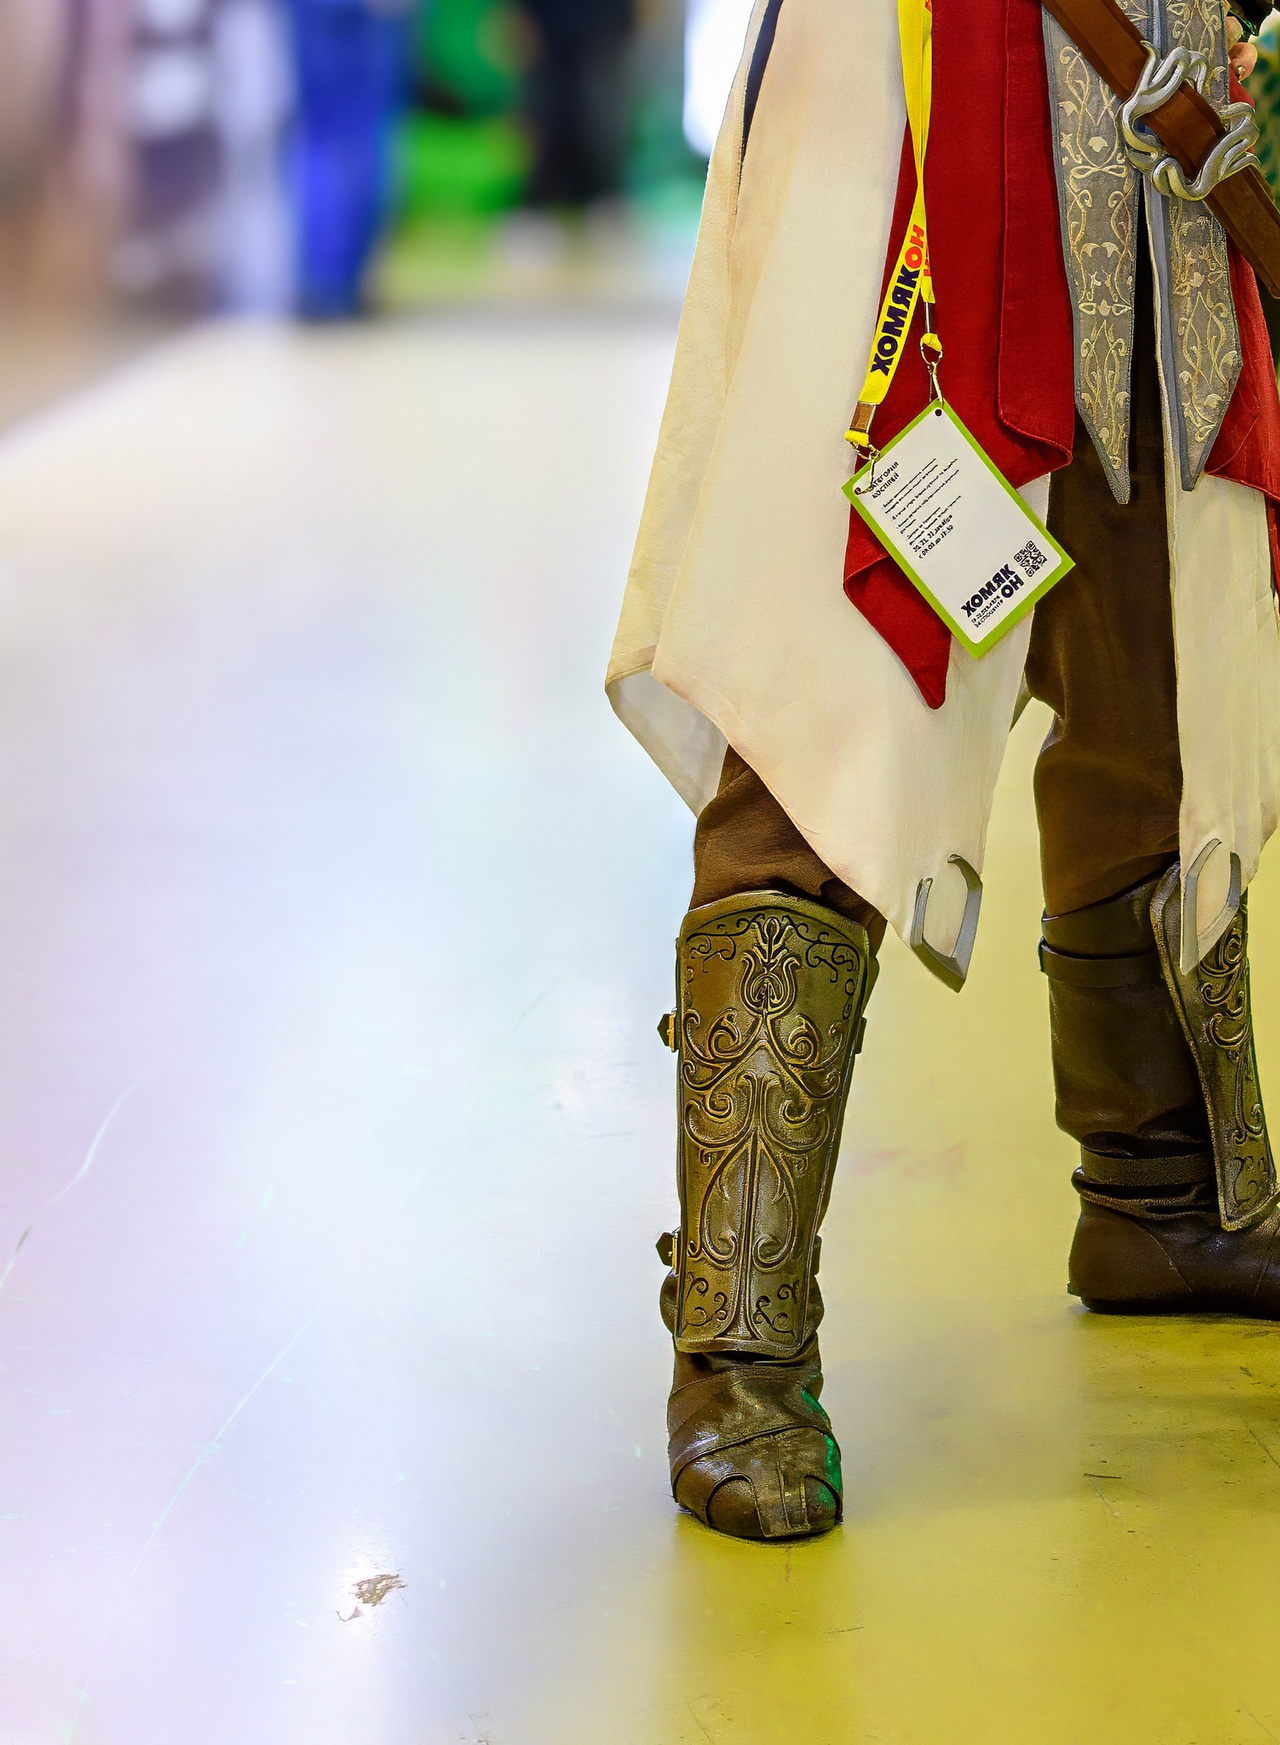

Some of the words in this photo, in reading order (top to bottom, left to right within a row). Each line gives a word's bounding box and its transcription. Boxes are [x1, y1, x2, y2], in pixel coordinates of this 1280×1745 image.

[870, 224, 924, 376] ХОМЯКОН
[960, 563, 1016, 618] ХОМЯК
[1000, 573, 1025, 599] ОН
